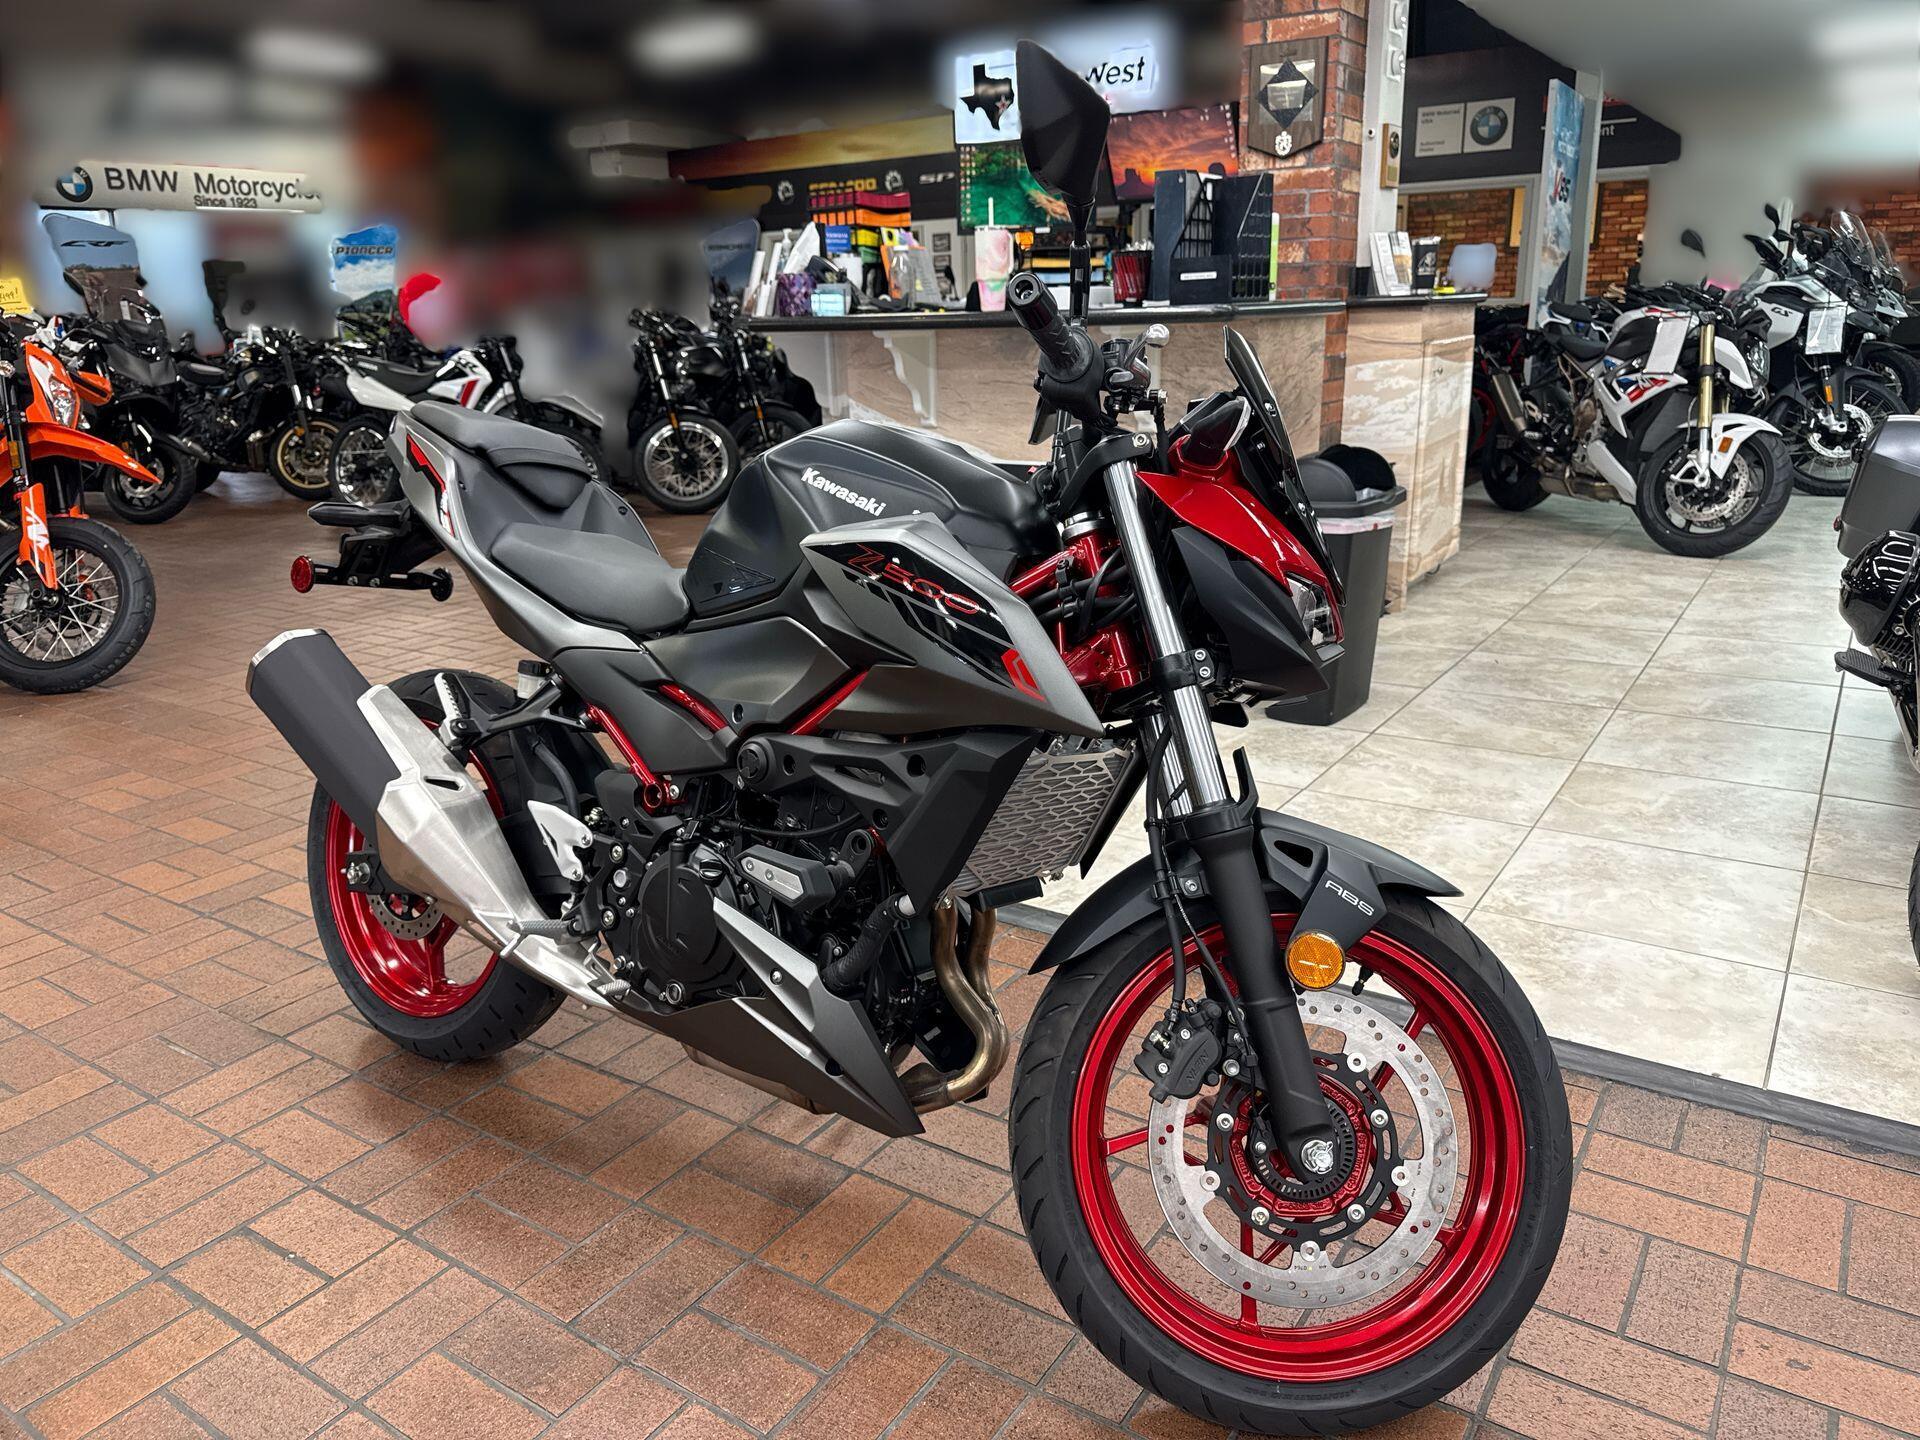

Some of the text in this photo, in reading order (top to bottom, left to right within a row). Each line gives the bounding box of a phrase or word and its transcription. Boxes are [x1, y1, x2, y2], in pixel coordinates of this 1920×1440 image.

[104, 167, 178, 192] BMW
[193, 194, 258, 208] Since 1923
[801, 467, 887, 517] Kawasaki
[847, 543, 980, 615] Z500
[1325, 880, 1375, 916] ABS
